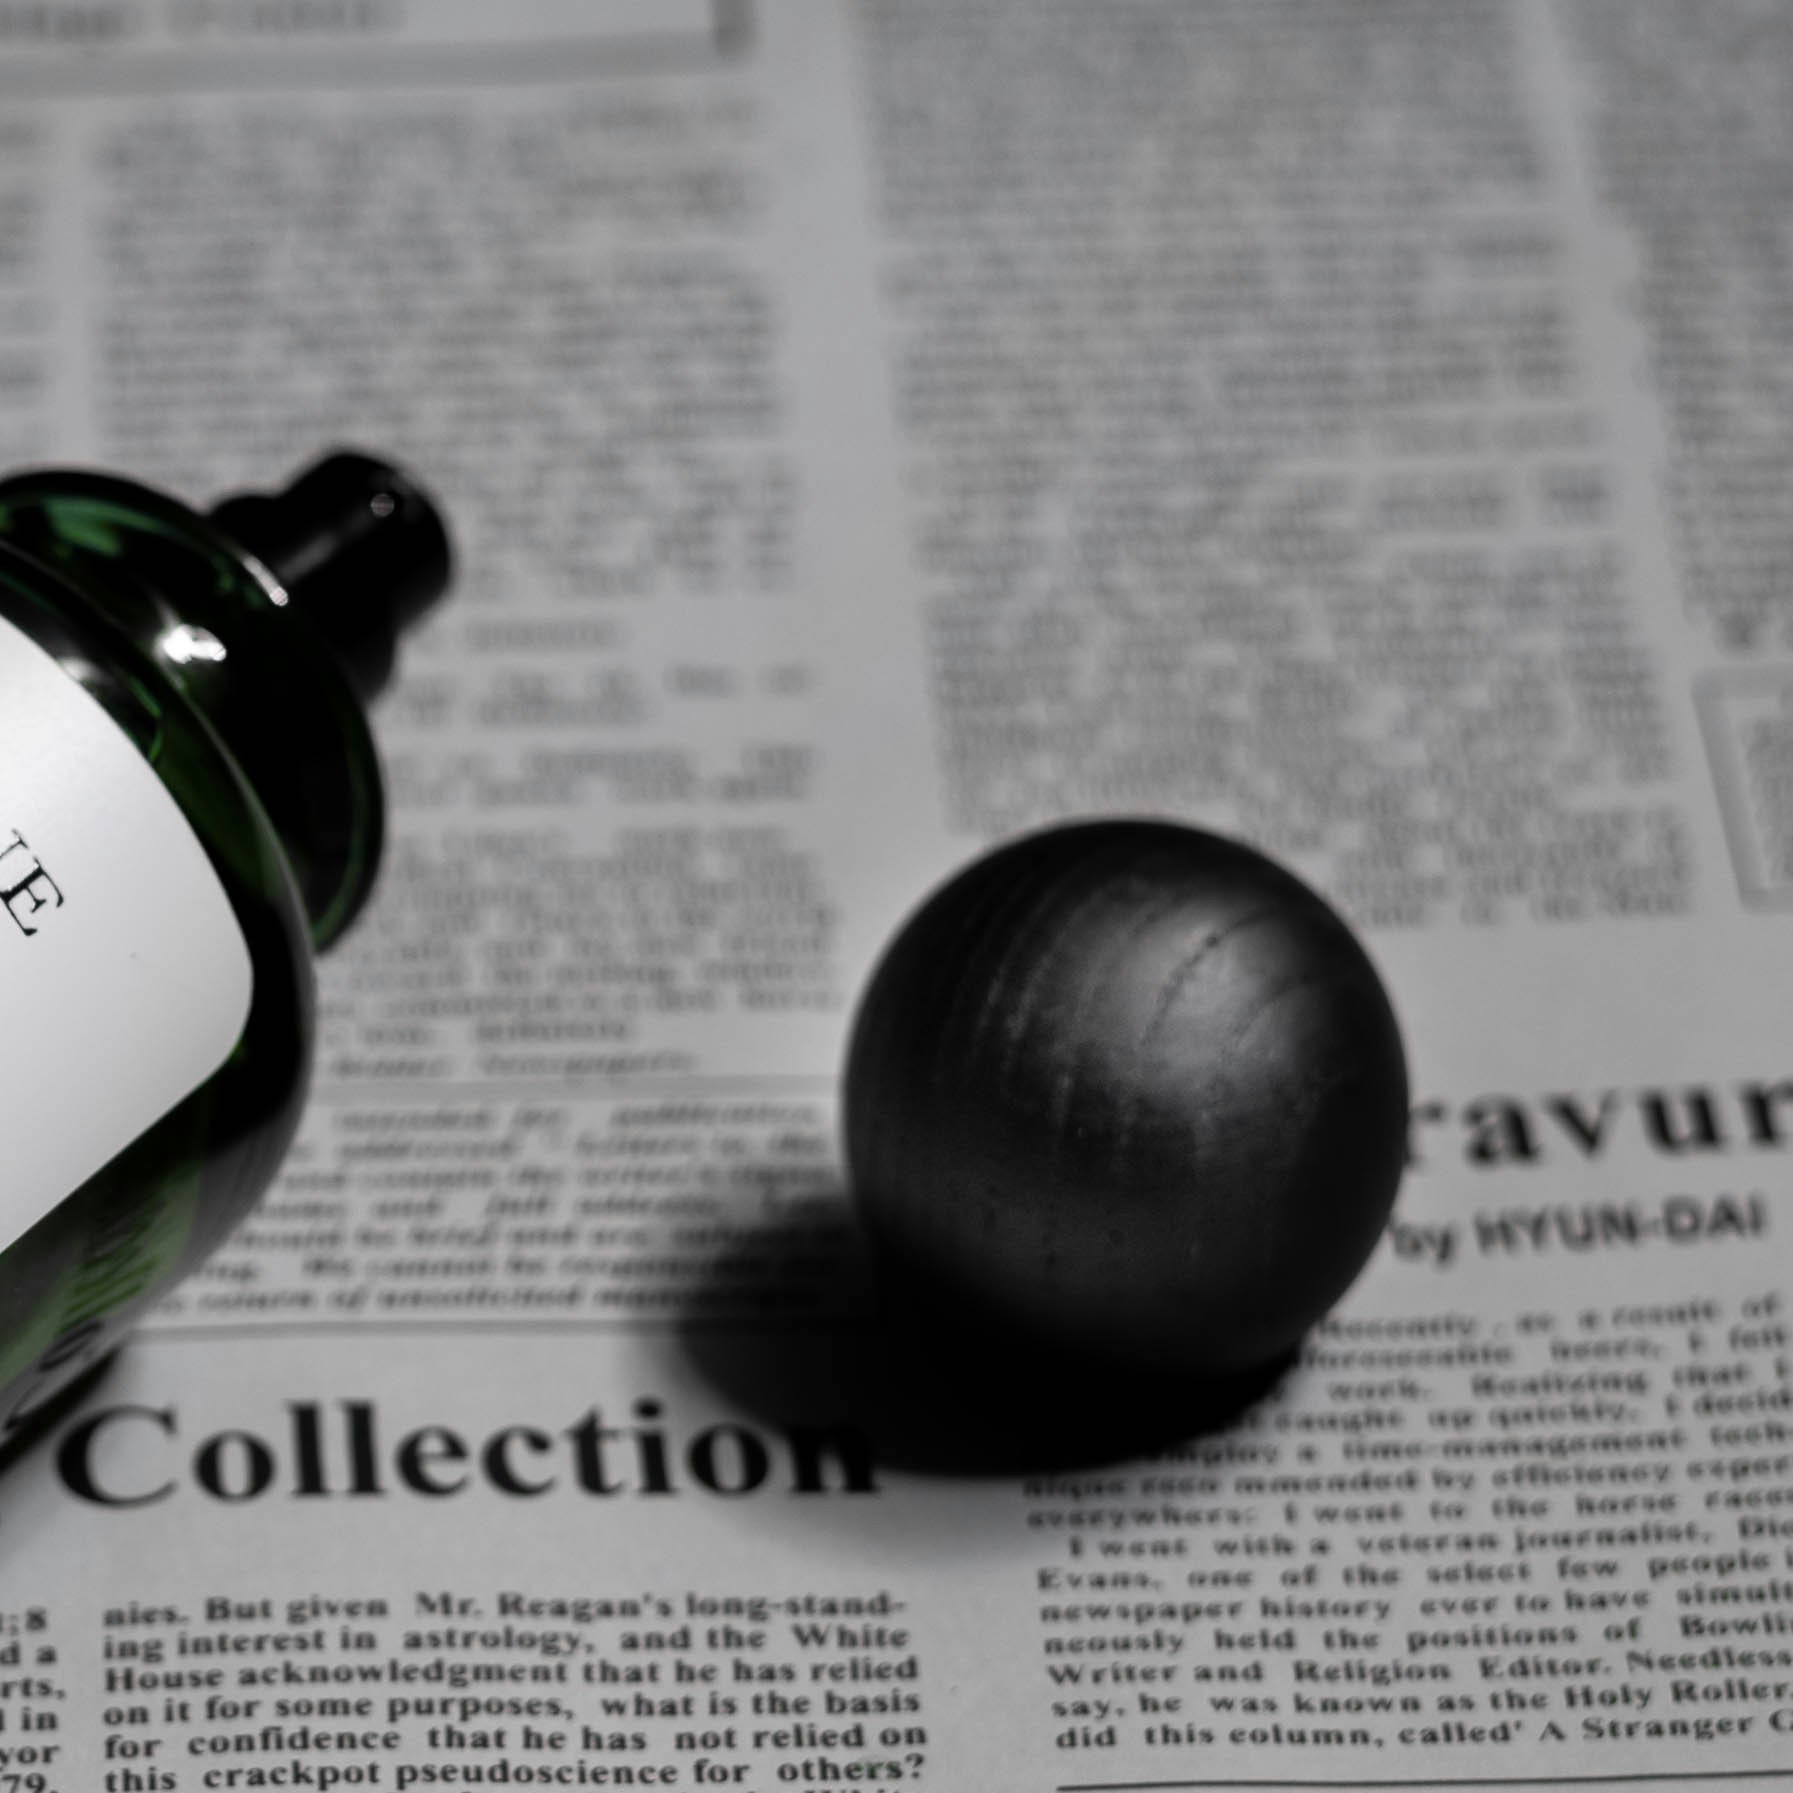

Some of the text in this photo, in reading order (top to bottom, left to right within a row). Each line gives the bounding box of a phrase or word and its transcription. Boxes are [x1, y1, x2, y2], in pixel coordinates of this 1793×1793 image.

[52, 1396, 884, 1509] Collection
[106, 1753, 925, 1793] this crackpot pseudoscience for others?
